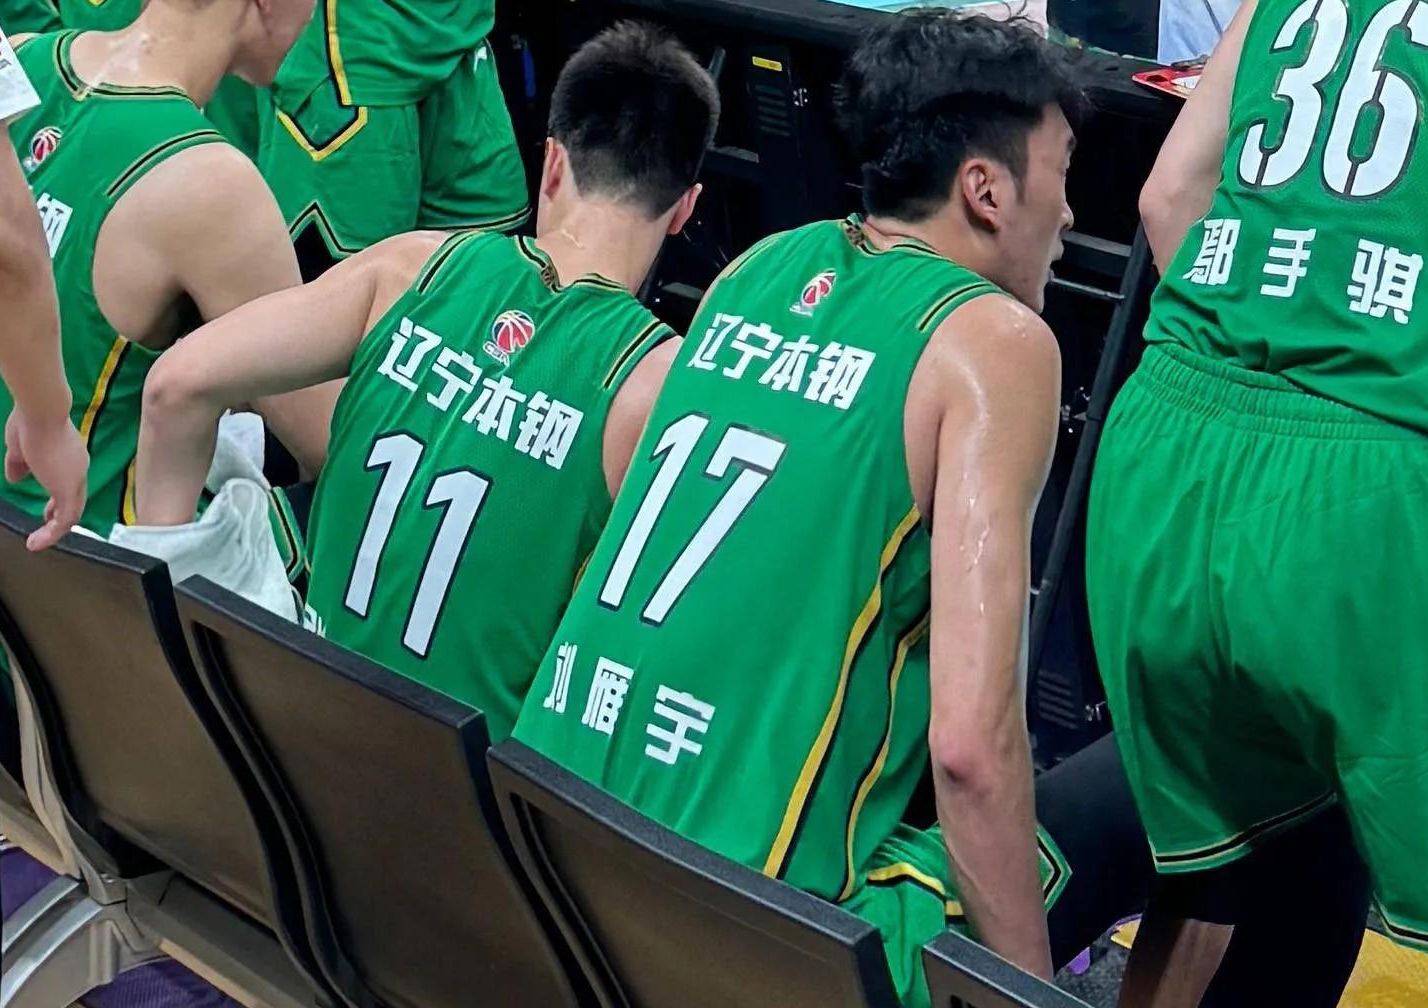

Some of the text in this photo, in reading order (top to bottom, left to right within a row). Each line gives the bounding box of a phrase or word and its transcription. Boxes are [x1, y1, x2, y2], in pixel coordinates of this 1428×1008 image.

[377, 317, 584, 470] 辽宁本钢
[686, 312, 876, 410] 辽宁本钢
[342, 430, 493, 659] 11
[597, 413, 788, 626] 17
[543, 641, 716, 765] 刘雁宇
